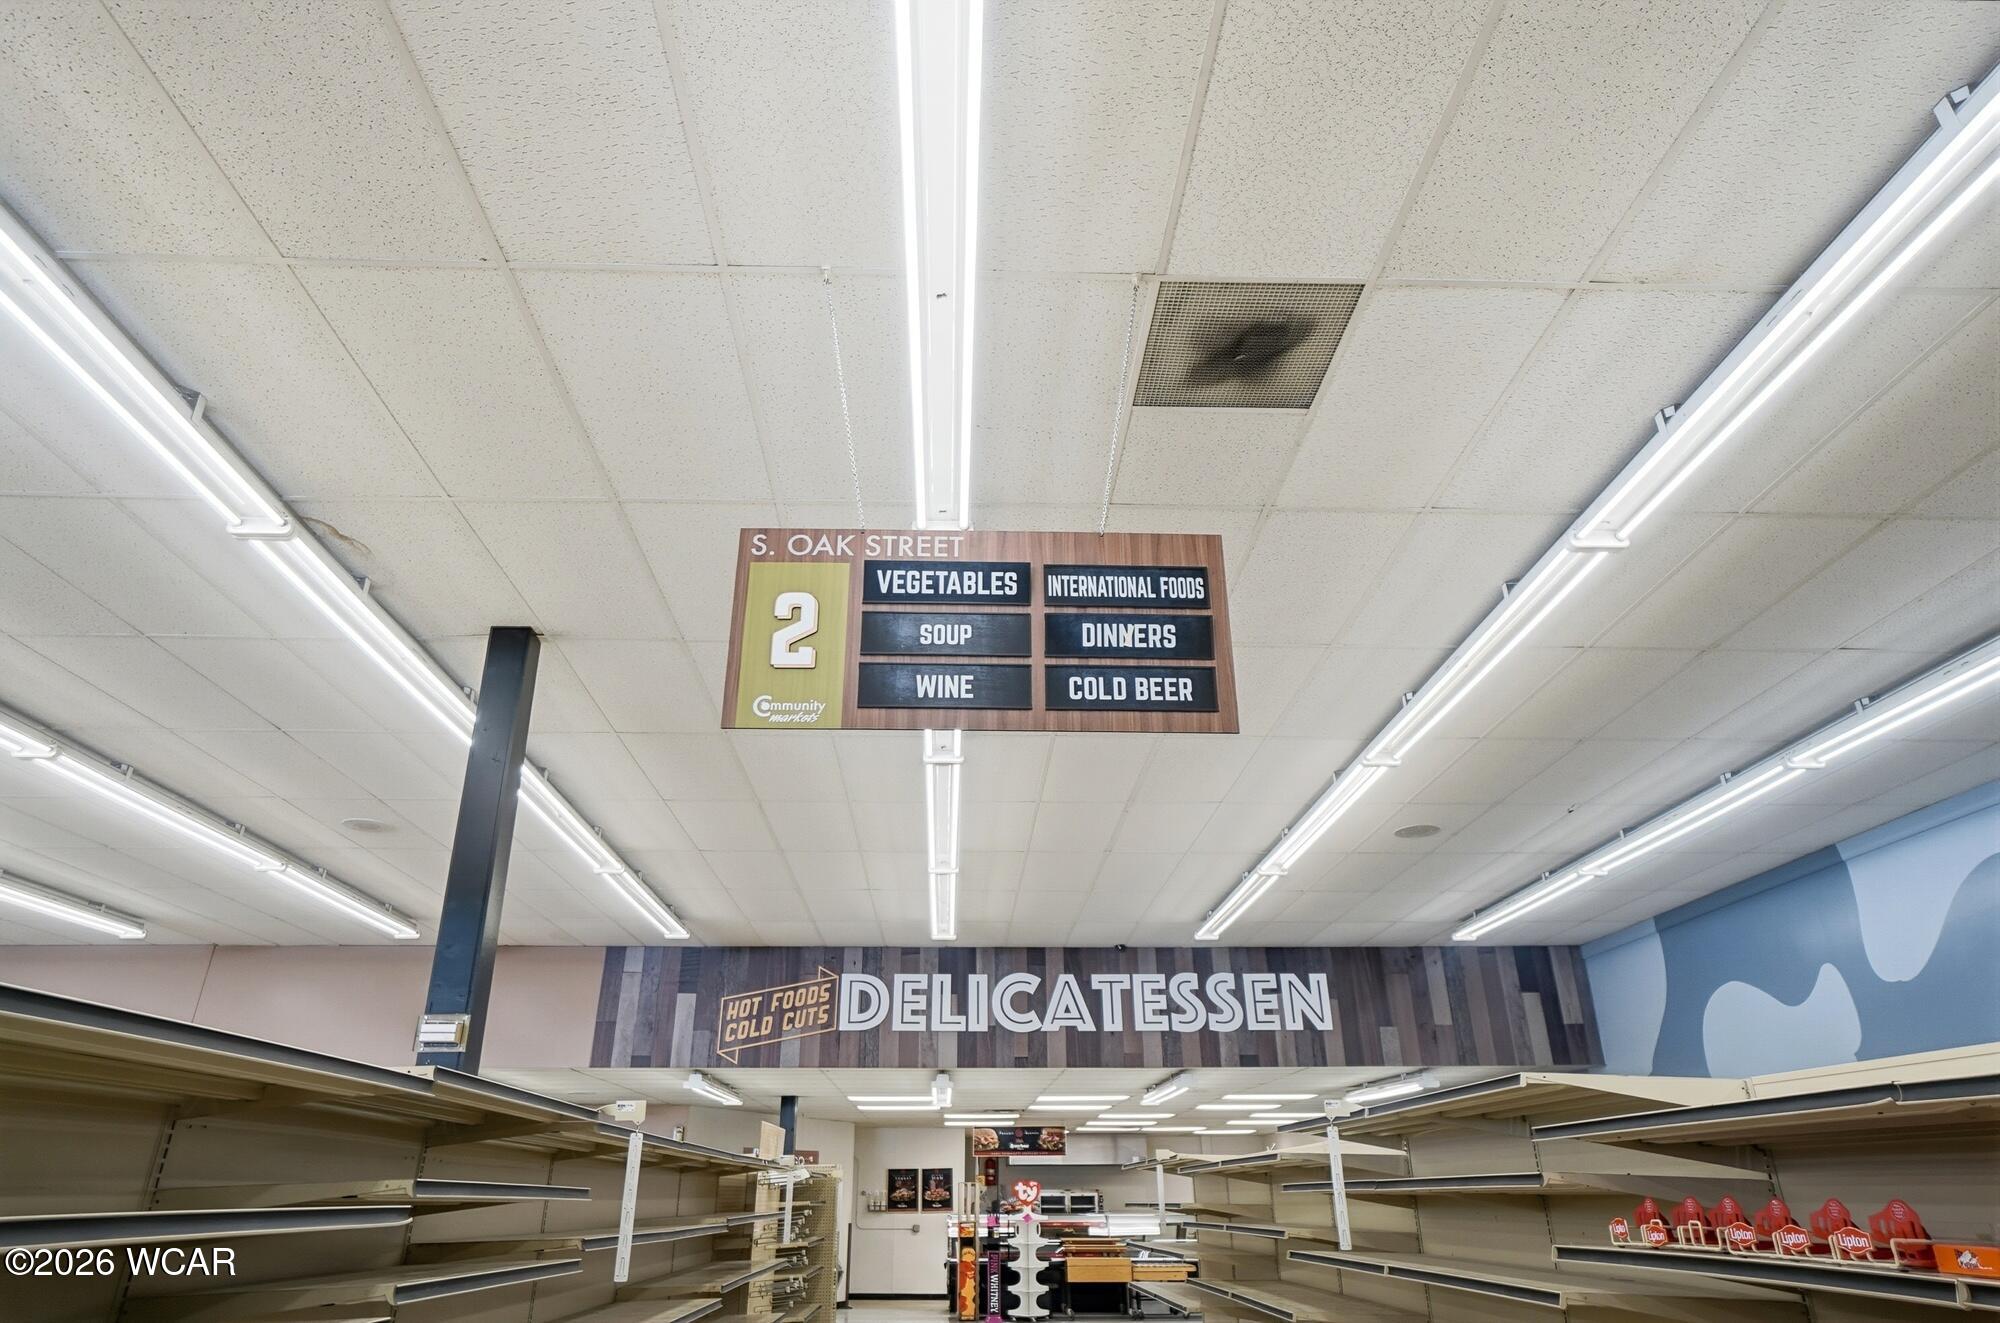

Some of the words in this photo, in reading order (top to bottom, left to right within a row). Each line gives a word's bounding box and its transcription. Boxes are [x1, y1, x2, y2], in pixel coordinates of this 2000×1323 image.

[750, 535, 775, 557] S.
[787, 534, 855, 557] OAK
[864, 535, 965, 558] STREET
[877, 569, 1018, 596] VEGETABLES
[1047, 574, 1157, 598] INTERNATIONAL
[1160, 576, 1206, 600] FOODS
[769, 592, 819, 669] 2
[919, 624, 973, 646] SOUP
[1082, 623, 1177, 649] DINNERS
[915, 675, 975, 700] WINE
[1068, 677, 1127, 702] COLD
[1135, 677, 1194, 702] BEER
[726, 996, 763, 1020] HOT
[771, 984, 832, 1012] FOODS
[838, 971, 1335, 1033] DELICATESSEN
[724, 1016, 773, 1042] COLD
[782, 1005, 830, 1031] CUTS
[1014, 1181, 1038, 1202] ty
[1646, 1230, 1666, 1242] Lipton
[1729, 1227, 1755, 1242] Lipton
[1782, 1229, 1809, 1246] Lipton
[1837, 1233, 1870, 1250] Lipton
[990, 1274, 999, 1313] WHITNEY
